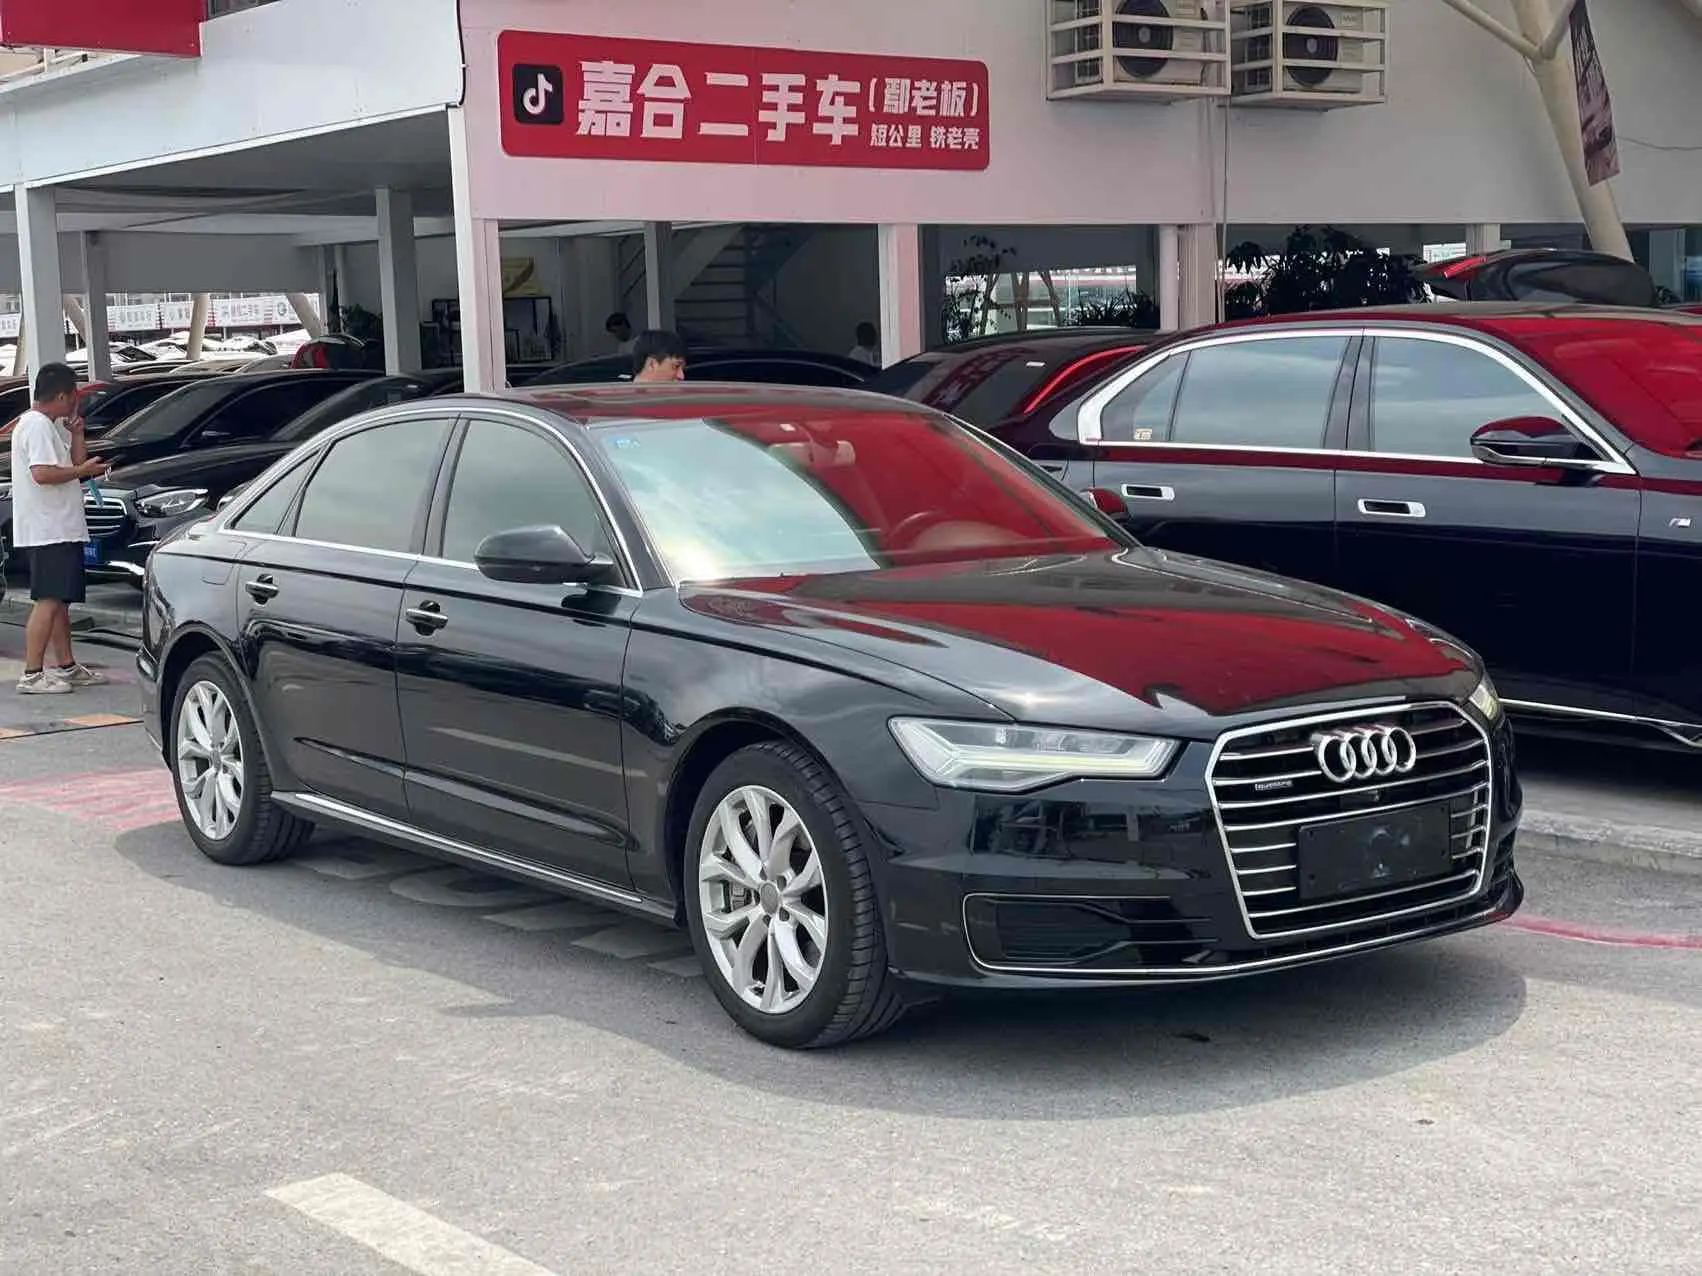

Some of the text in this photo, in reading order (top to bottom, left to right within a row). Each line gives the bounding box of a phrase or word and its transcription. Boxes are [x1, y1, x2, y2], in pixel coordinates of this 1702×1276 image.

[576, 60, 861, 145] 嘉合二手车
[868, 123, 922, 148] 短公里
